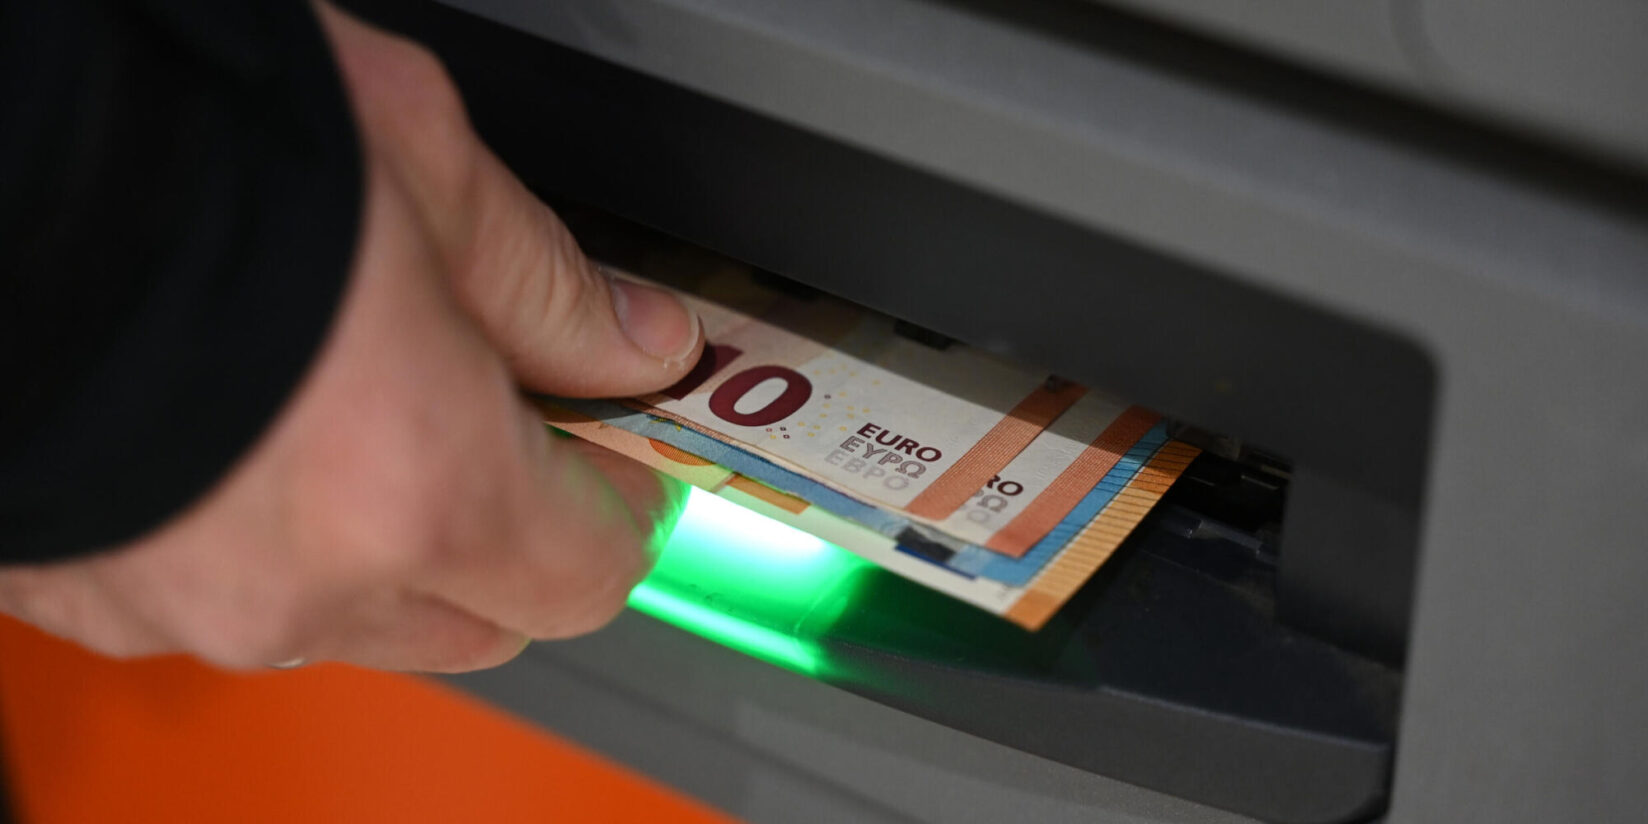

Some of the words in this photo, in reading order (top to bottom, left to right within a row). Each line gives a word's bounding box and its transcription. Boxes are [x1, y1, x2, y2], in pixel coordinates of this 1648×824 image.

[840, 435, 927, 479] ΕΥΡΩ
[856, 422, 942, 462] EURO
[824, 449, 910, 491] ЕВРО
